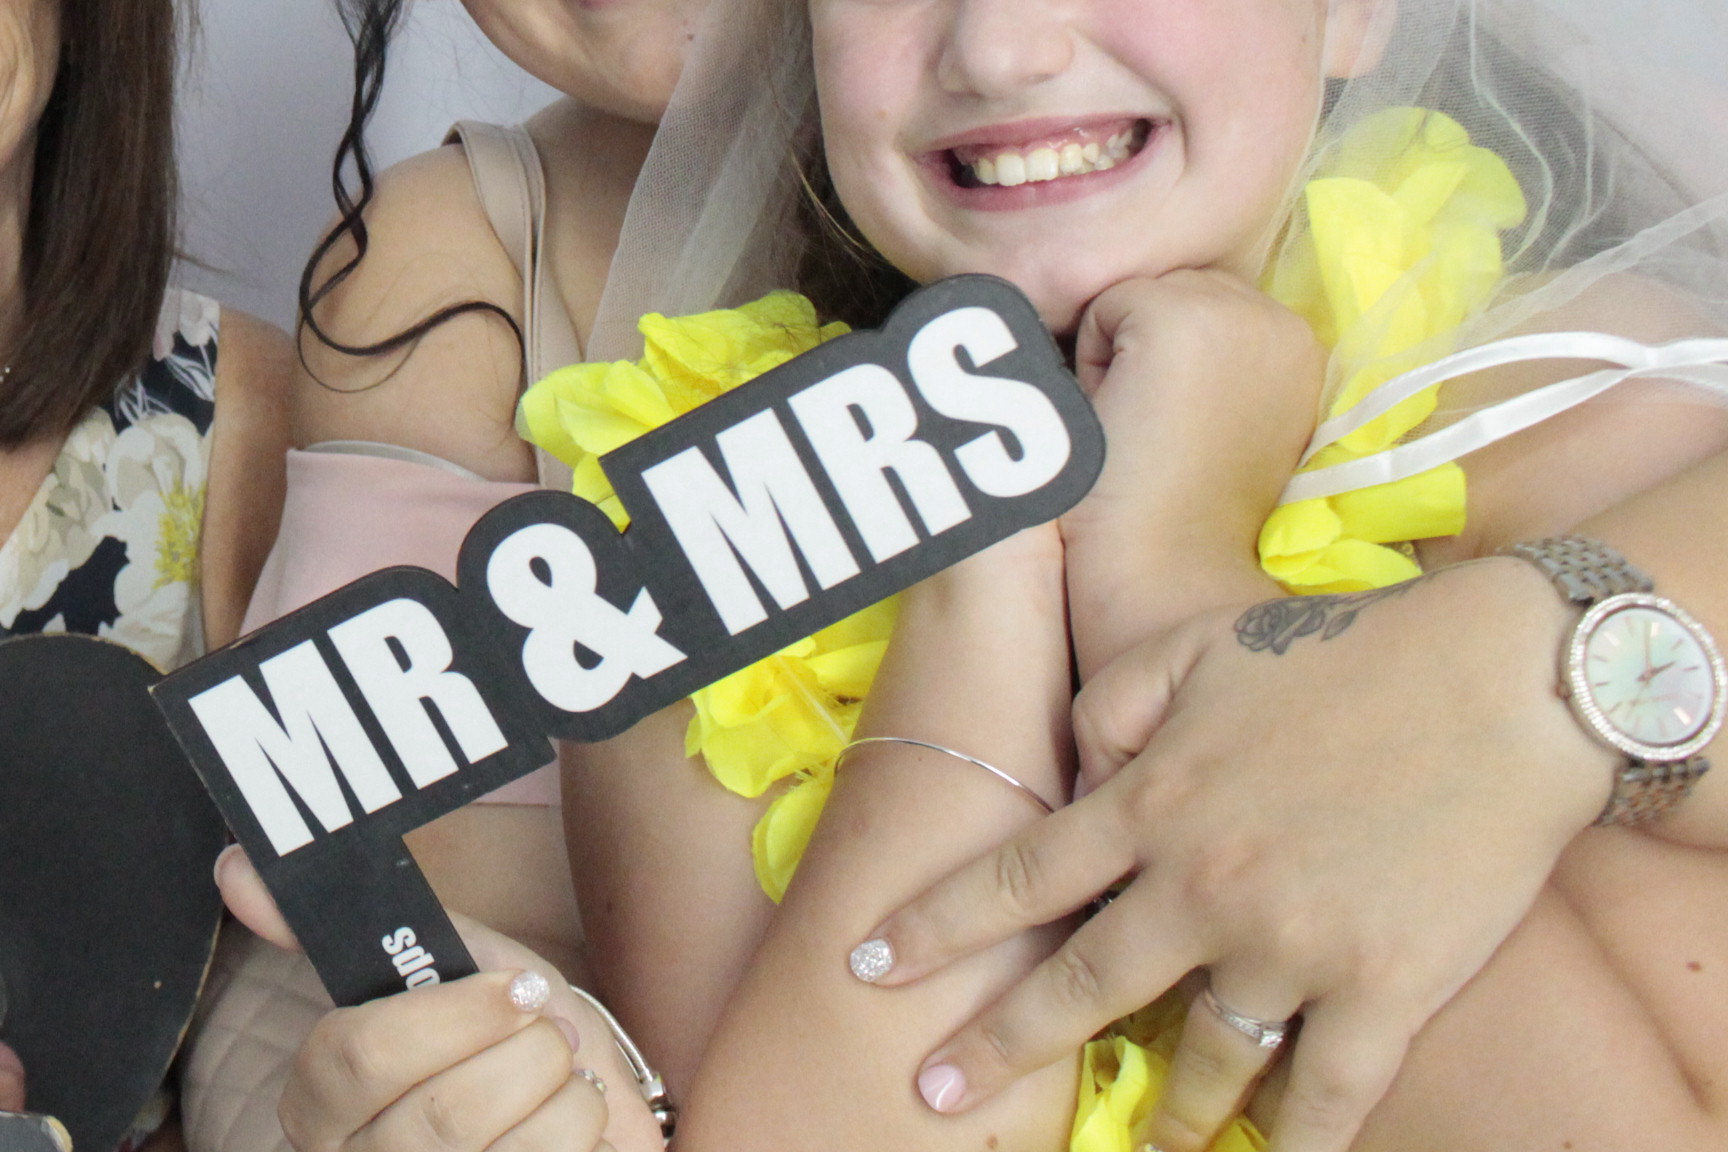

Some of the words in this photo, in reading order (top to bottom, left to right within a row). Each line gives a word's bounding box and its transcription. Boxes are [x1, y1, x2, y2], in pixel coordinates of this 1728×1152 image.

[188, 597, 508, 856] MR
[486, 522, 688, 712] &
[641, 306, 1072, 636] MRS
[381, 926, 441, 991] ops
